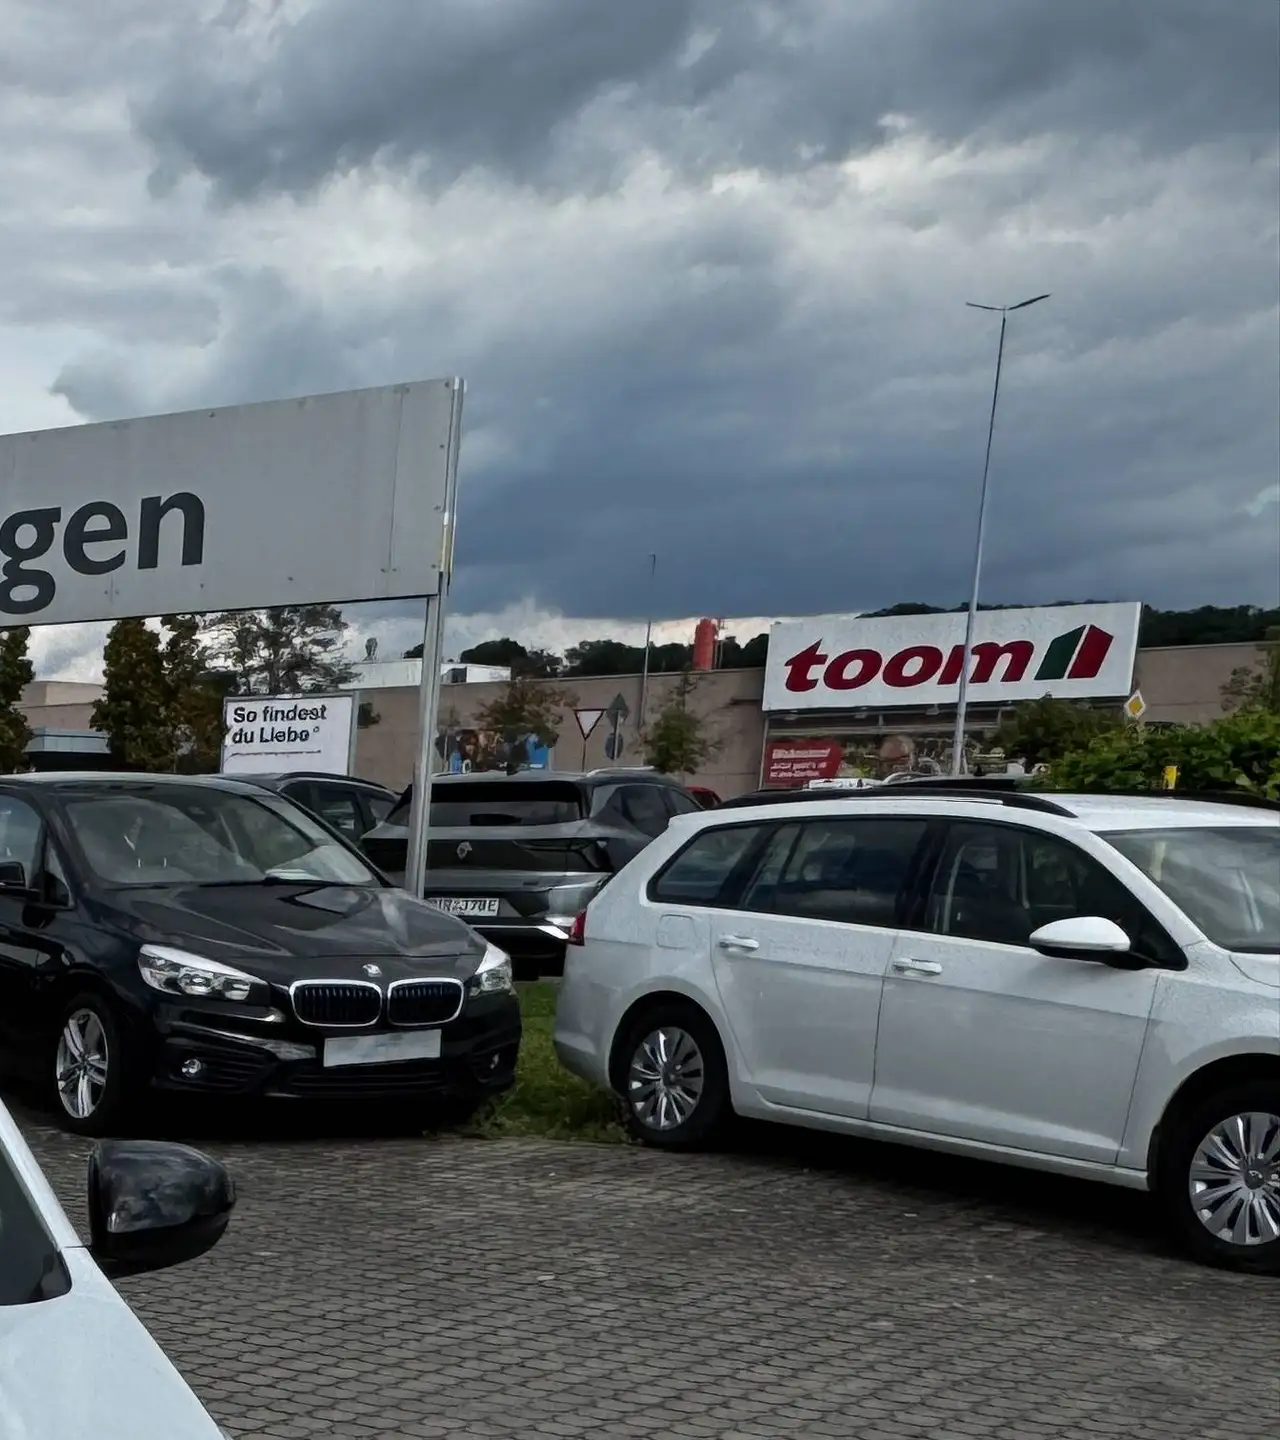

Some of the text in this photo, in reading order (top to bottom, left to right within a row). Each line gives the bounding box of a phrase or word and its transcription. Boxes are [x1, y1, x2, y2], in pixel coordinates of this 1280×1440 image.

[784, 637, 1035, 693] toom
[233, 704, 328, 723] So findest
[232, 728, 255, 744] du
